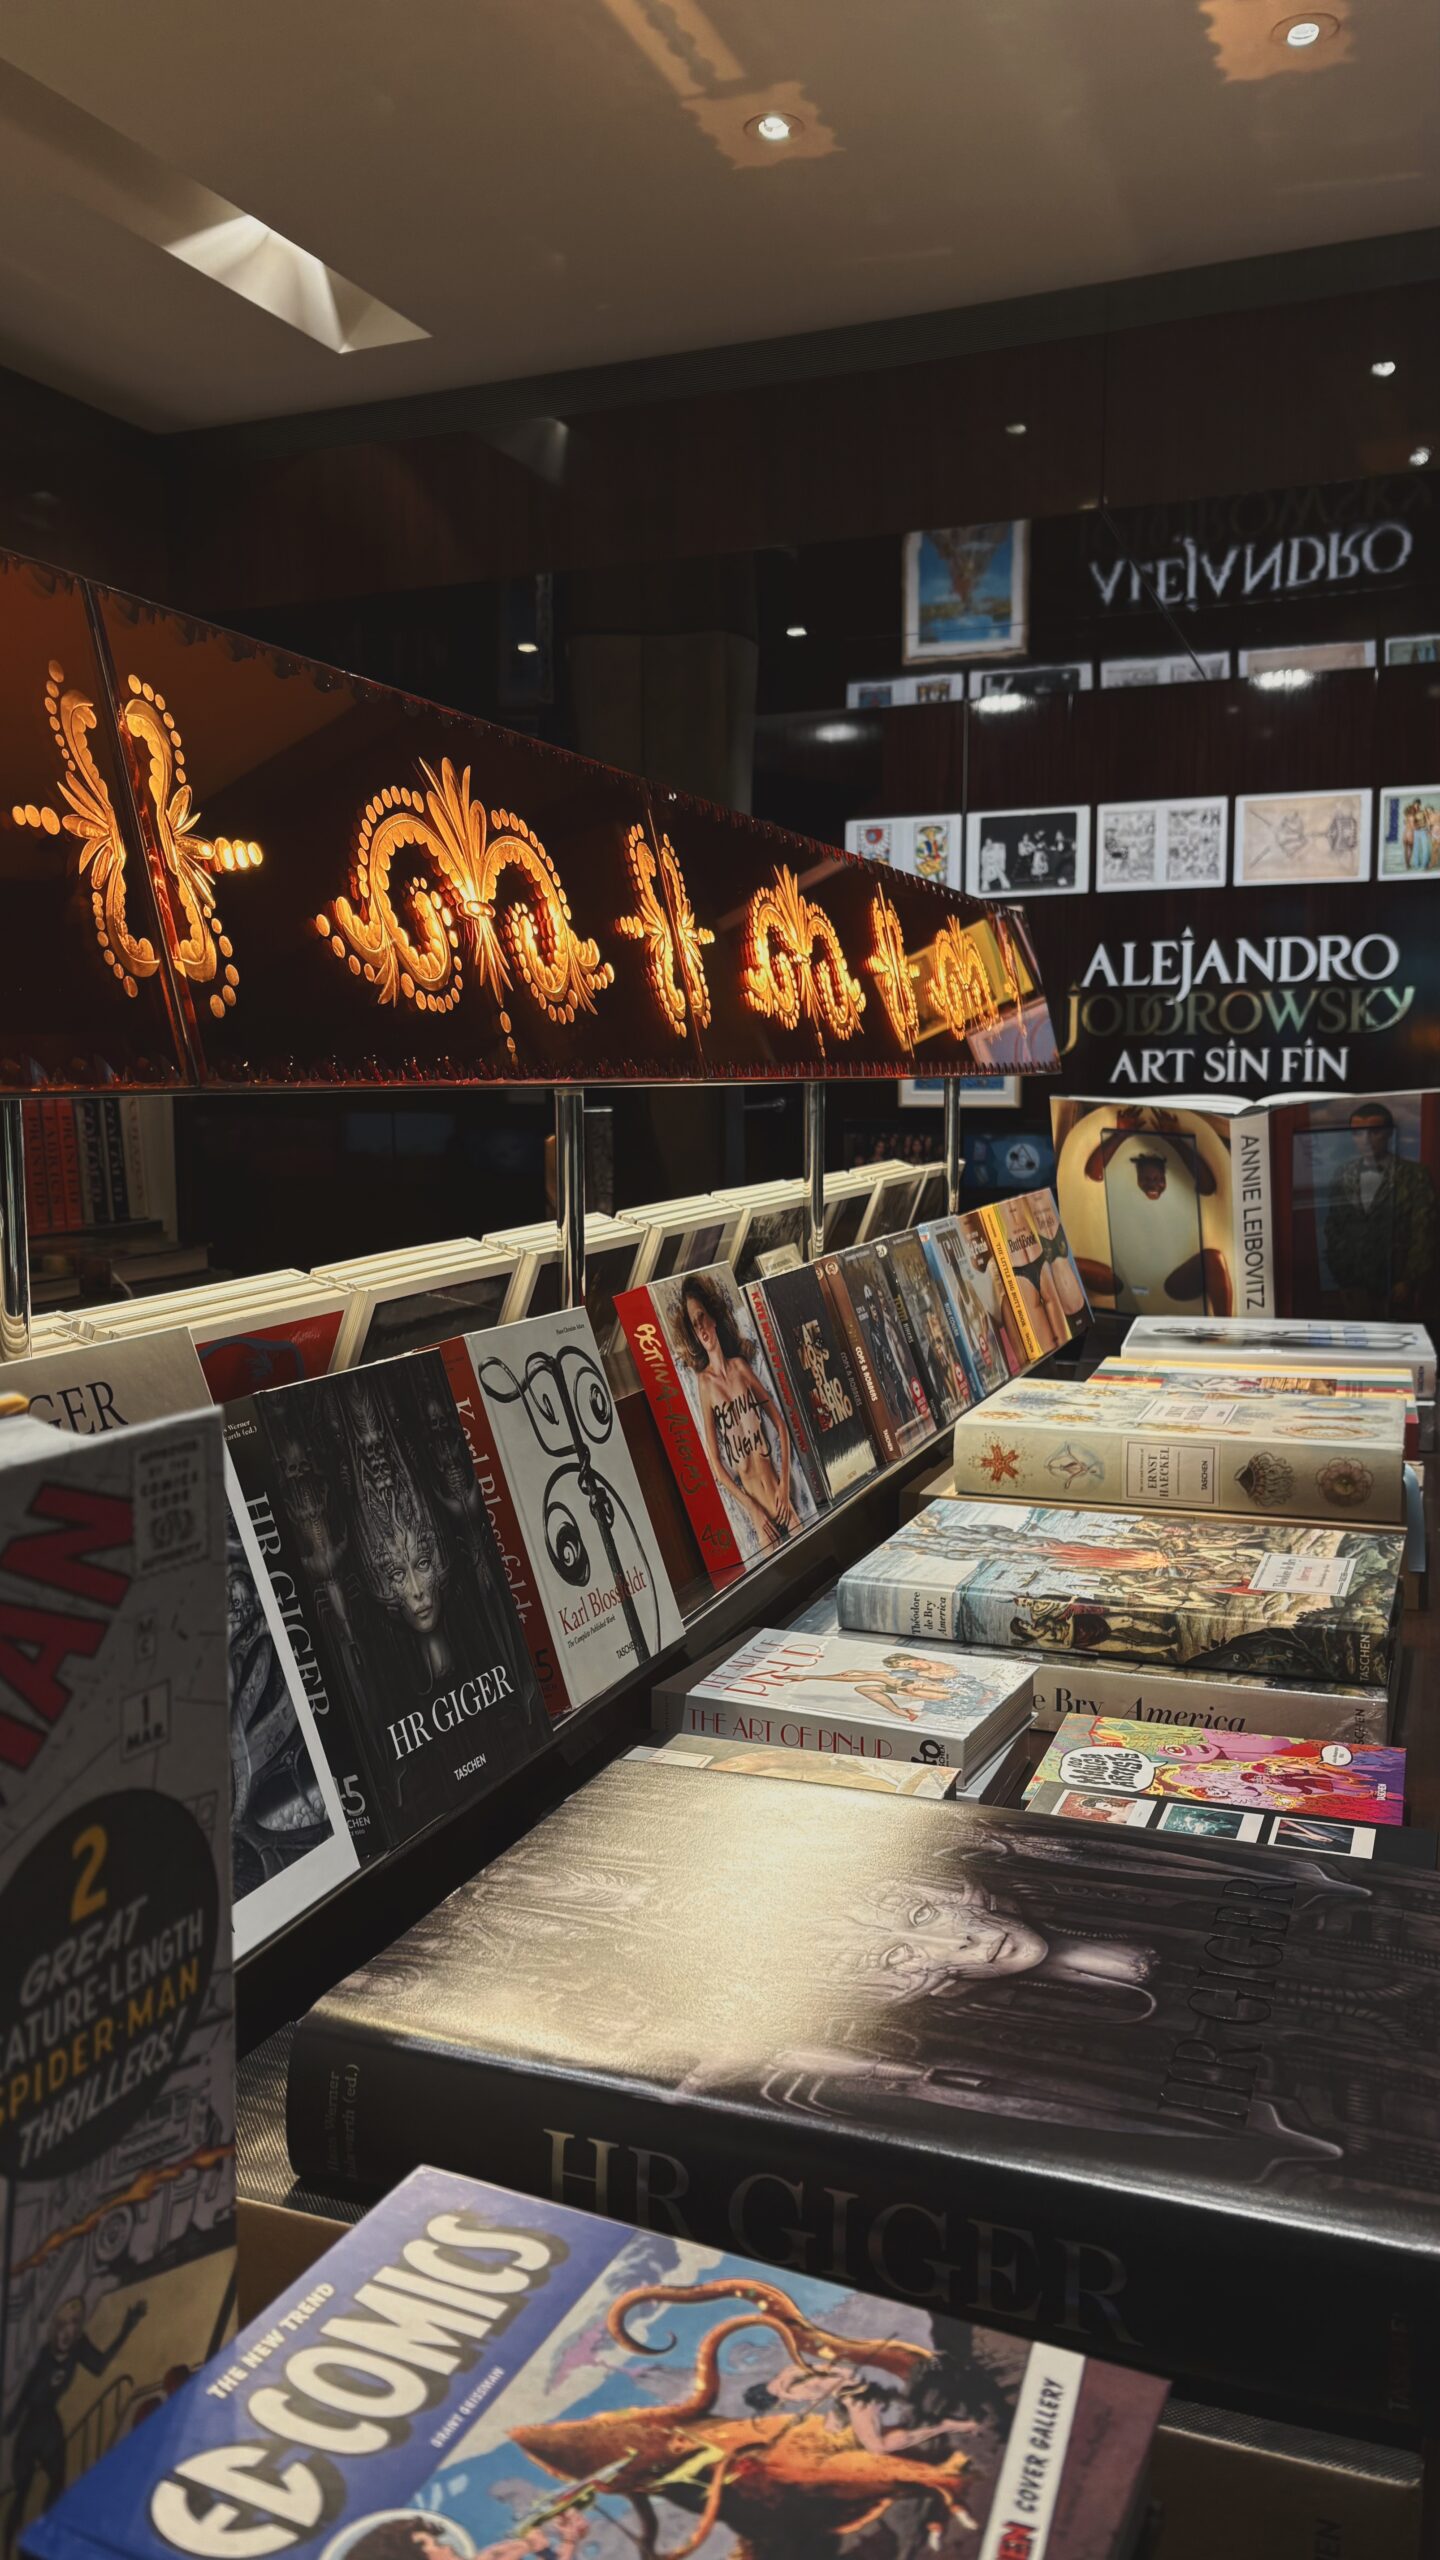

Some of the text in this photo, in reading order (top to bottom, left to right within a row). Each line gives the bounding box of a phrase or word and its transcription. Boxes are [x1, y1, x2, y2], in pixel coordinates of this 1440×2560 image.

[1109, 1046, 1195, 1084] ART
[1240, 1134, 1265, 1311] ANNIE LEIBOVITZ
[751, 1291, 768, 1321] KATE
[855, 1346, 865, 1366] COPS
[864, 1372, 878, 1402] ROBBERS
[711, 1387, 770, 1432] BETTINA
[1147, 1453, 1158, 1489] ERNST
[1159, 1447, 1170, 1498] HAECKEL
[1200, 1460, 1208, 1491] TASCHEN
[557, 1565, 648, 1636] Karl Blossfeldt
[910, 1591, 921, 1635] Théodore
[924, 1600, 937, 1630] de Bry
[937, 1596, 948, 1637] America
[723, 1643, 825, 1698] PIN-UP
[1360, 1634, 1371, 1682] TASCHEN
[386, 1664, 515, 1760] HR GIGER
[688, 1708, 728, 1736] THE
[732, 1716, 775, 1743] ART
[780, 1722, 814, 1748] OF
[818, 1728, 893, 1759] PIN-UP
[1055, 1687, 1104, 1715] Bry
[1117, 1696, 1248, 1733] America
[452, 1752, 488, 1782] TASCHEN
[1103, 1752, 1143, 1789] ARTISTS
[70, 1824, 108, 1923] 2
[20, 1894, 149, 2008] GREAT
[0, 1908, 205, 2076] ATURE-LENGTH
[1158, 1879, 1298, 2126] HR GIGER
[18, 2005, 190, 2169] THRILLERS!
[542, 2127, 1146, 2348] HR GIGER
[206, 2282, 336, 2400] THE NEW TREND
[150, 2212, 552, 2559] EC COMICS
[1029, 2376, 1066, 2451] GALLERY
[1013, 2453, 1050, 2514] COVER
